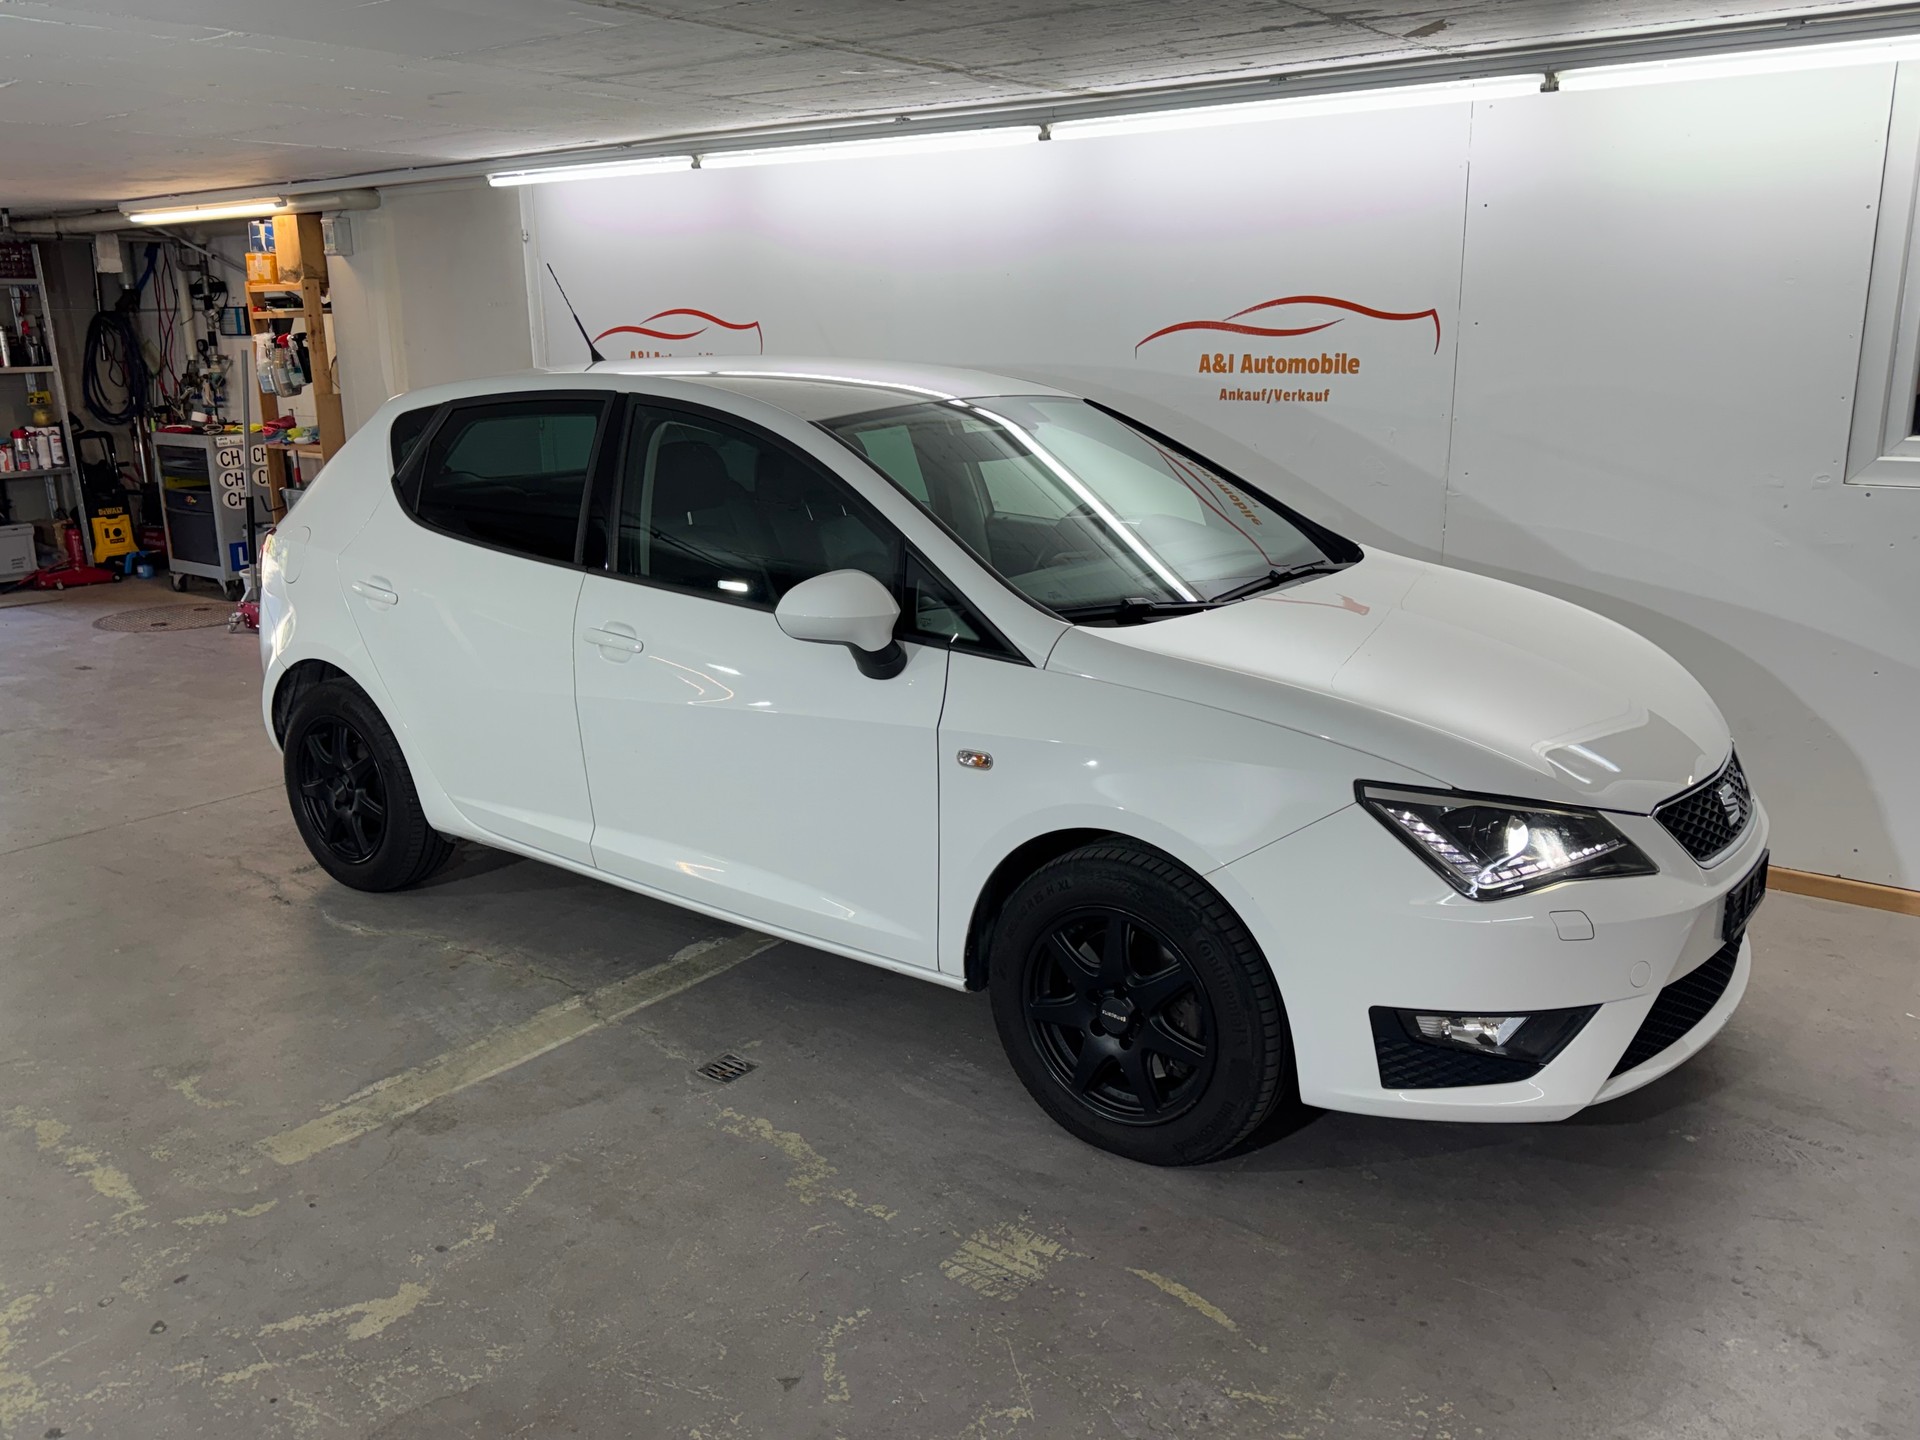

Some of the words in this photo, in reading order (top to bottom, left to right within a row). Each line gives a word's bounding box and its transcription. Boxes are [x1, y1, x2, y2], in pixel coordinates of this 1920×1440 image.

[1199, 353, 1235, 374] A&I
[1240, 353, 1360, 374] Automobile
[1219, 388, 1330, 403] Ankauf/Verkauf
[220, 450, 241, 467] CH
[224, 472, 245, 487] CH
